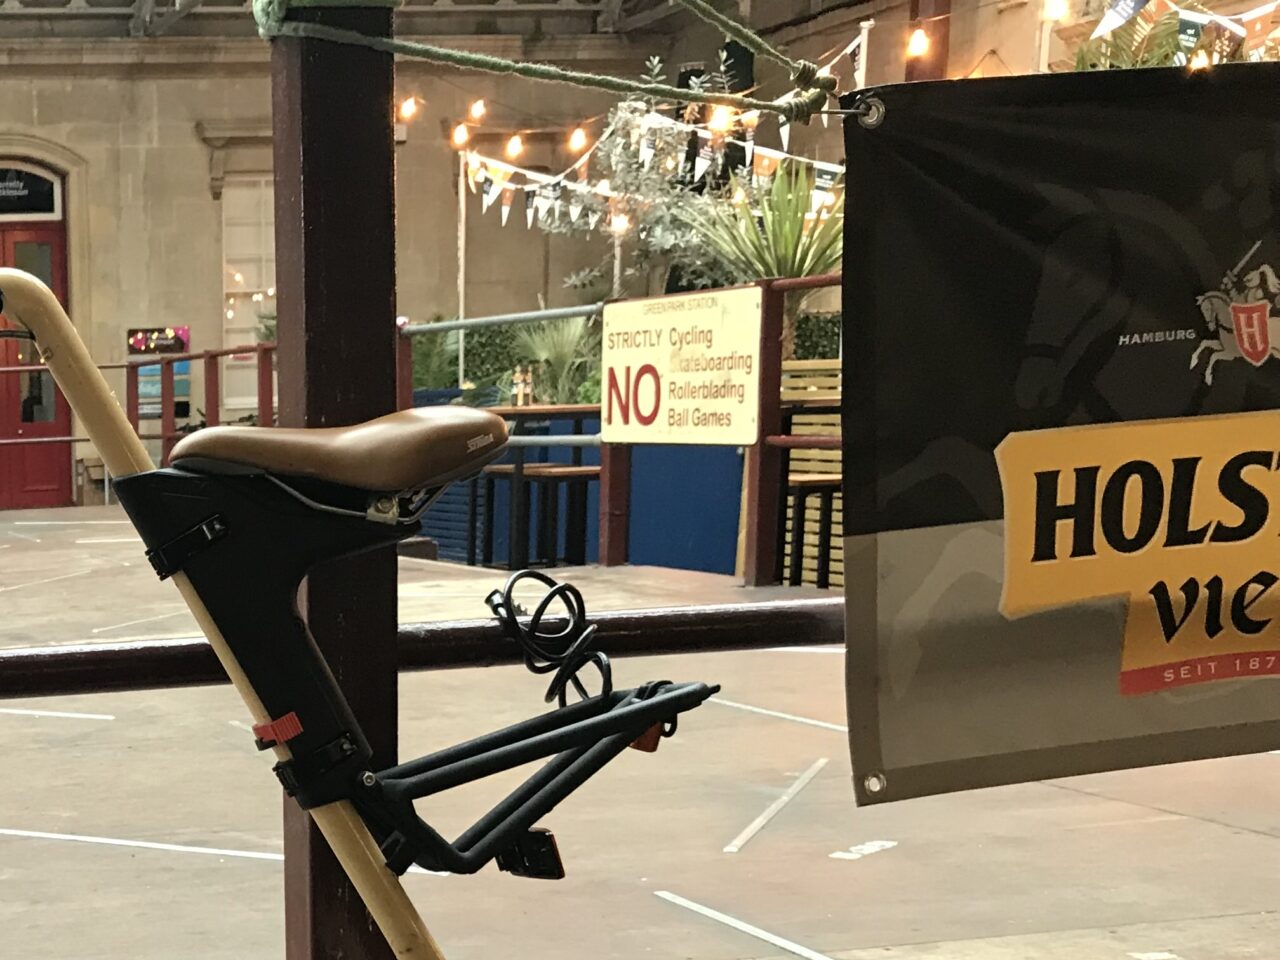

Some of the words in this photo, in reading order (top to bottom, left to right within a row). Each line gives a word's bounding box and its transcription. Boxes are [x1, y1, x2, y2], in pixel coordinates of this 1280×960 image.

[607, 329, 663, 350] STRICTLY
[669, 325, 713, 351] Cycling
[1118, 328, 1196, 346] HAMBURG
[1238, 311, 1265, 353] H
[606, 363, 662, 427] NO
[668, 379, 745, 404] Rollerblading
[667, 408, 689, 428] Ball
[691, 407, 732, 427] Games
[1031, 450, 1280, 563] HOLS
[1163, 661, 1218, 682] SEIT
